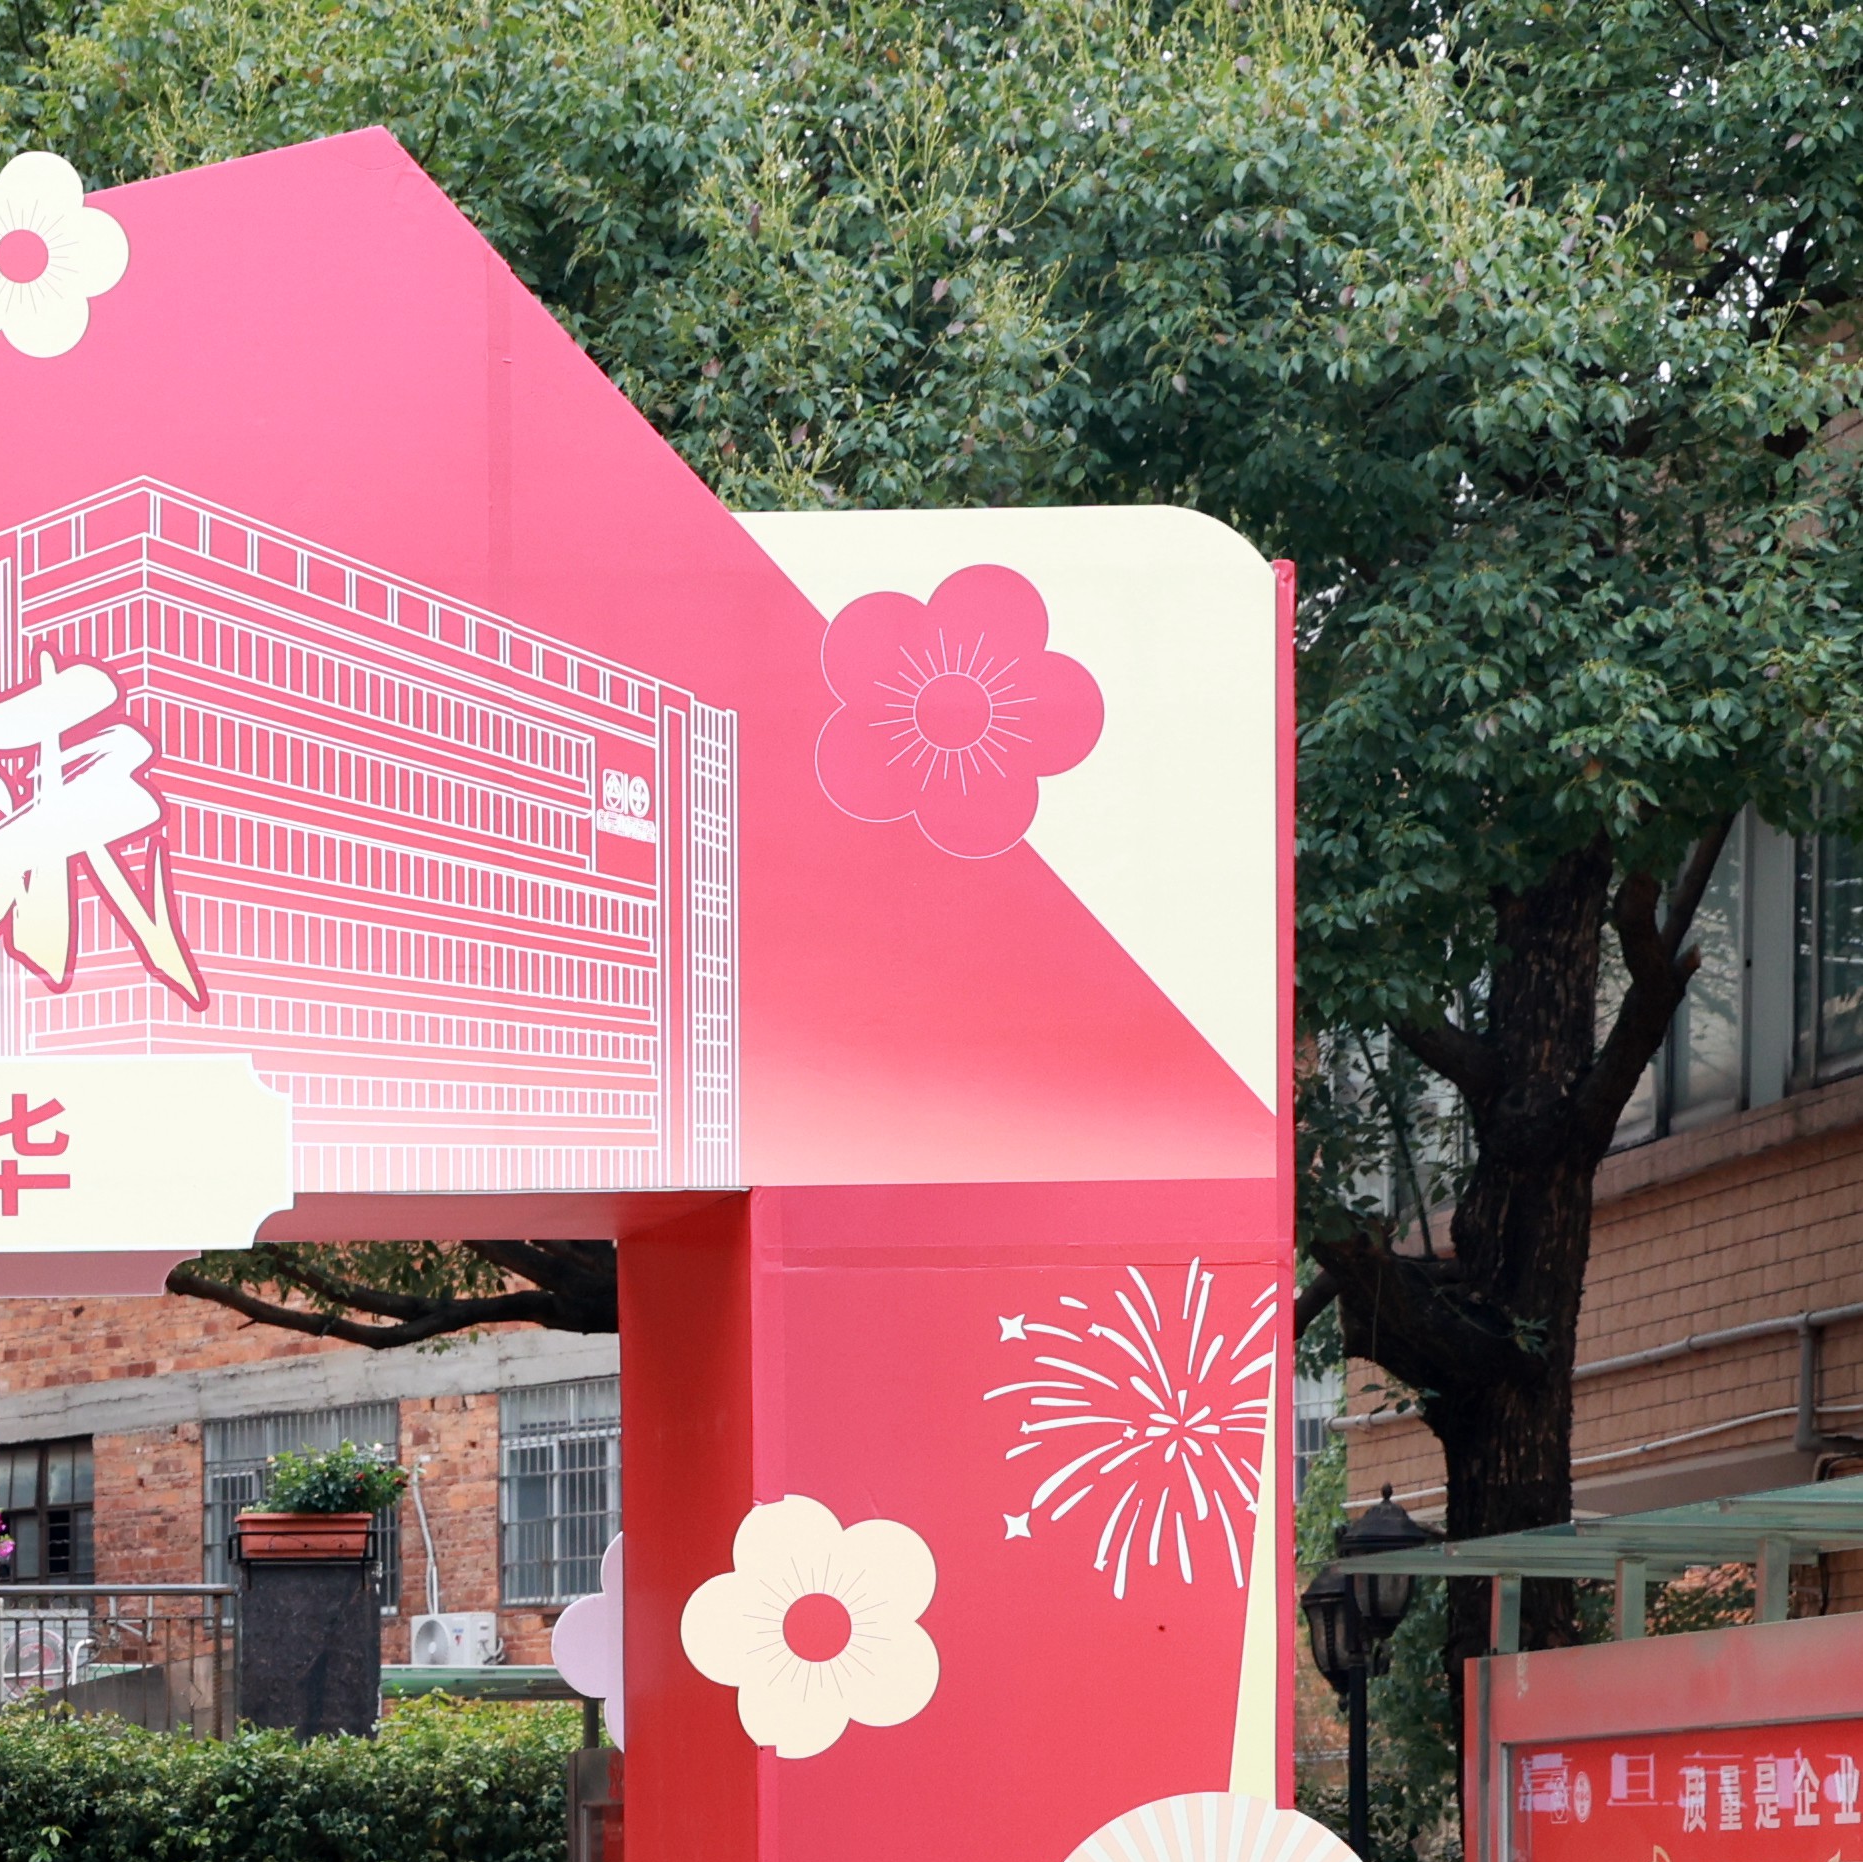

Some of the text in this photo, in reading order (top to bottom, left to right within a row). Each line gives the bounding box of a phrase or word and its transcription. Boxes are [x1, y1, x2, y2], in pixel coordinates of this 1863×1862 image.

[1683, 1757, 1861, 1833] 质量是企业
